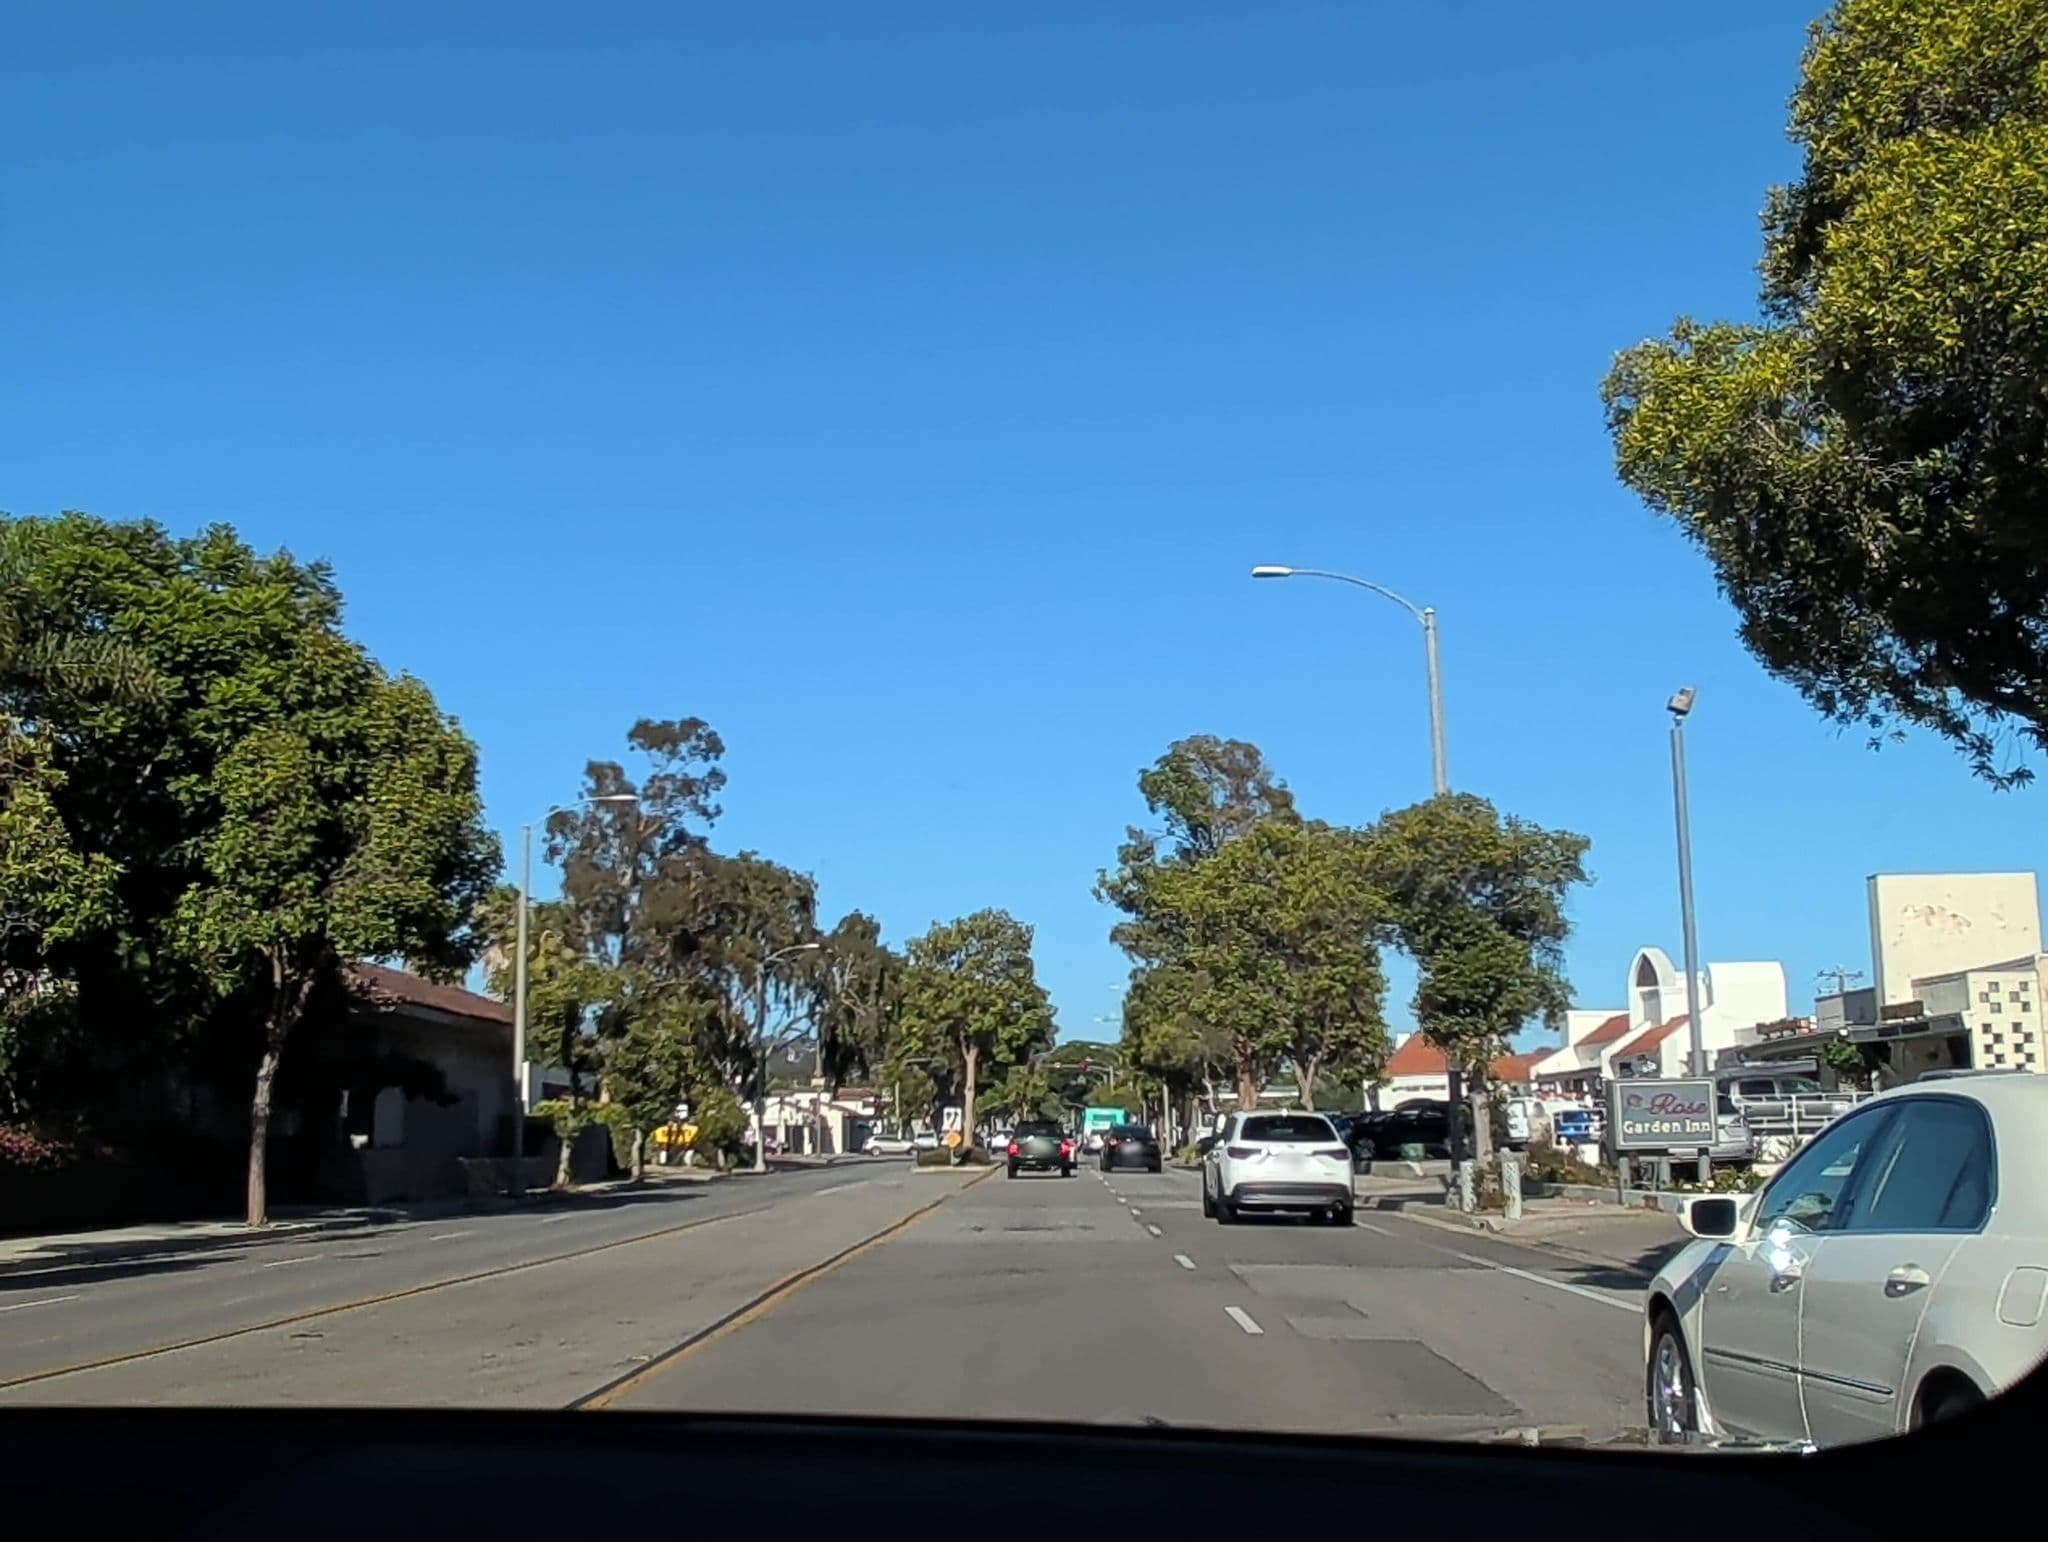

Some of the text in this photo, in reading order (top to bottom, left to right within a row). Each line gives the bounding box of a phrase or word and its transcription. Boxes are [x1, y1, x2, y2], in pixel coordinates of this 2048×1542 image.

[1649, 1093, 1707, 1115] Rose
[1623, 1119, 1711, 1134] Garden Inn
